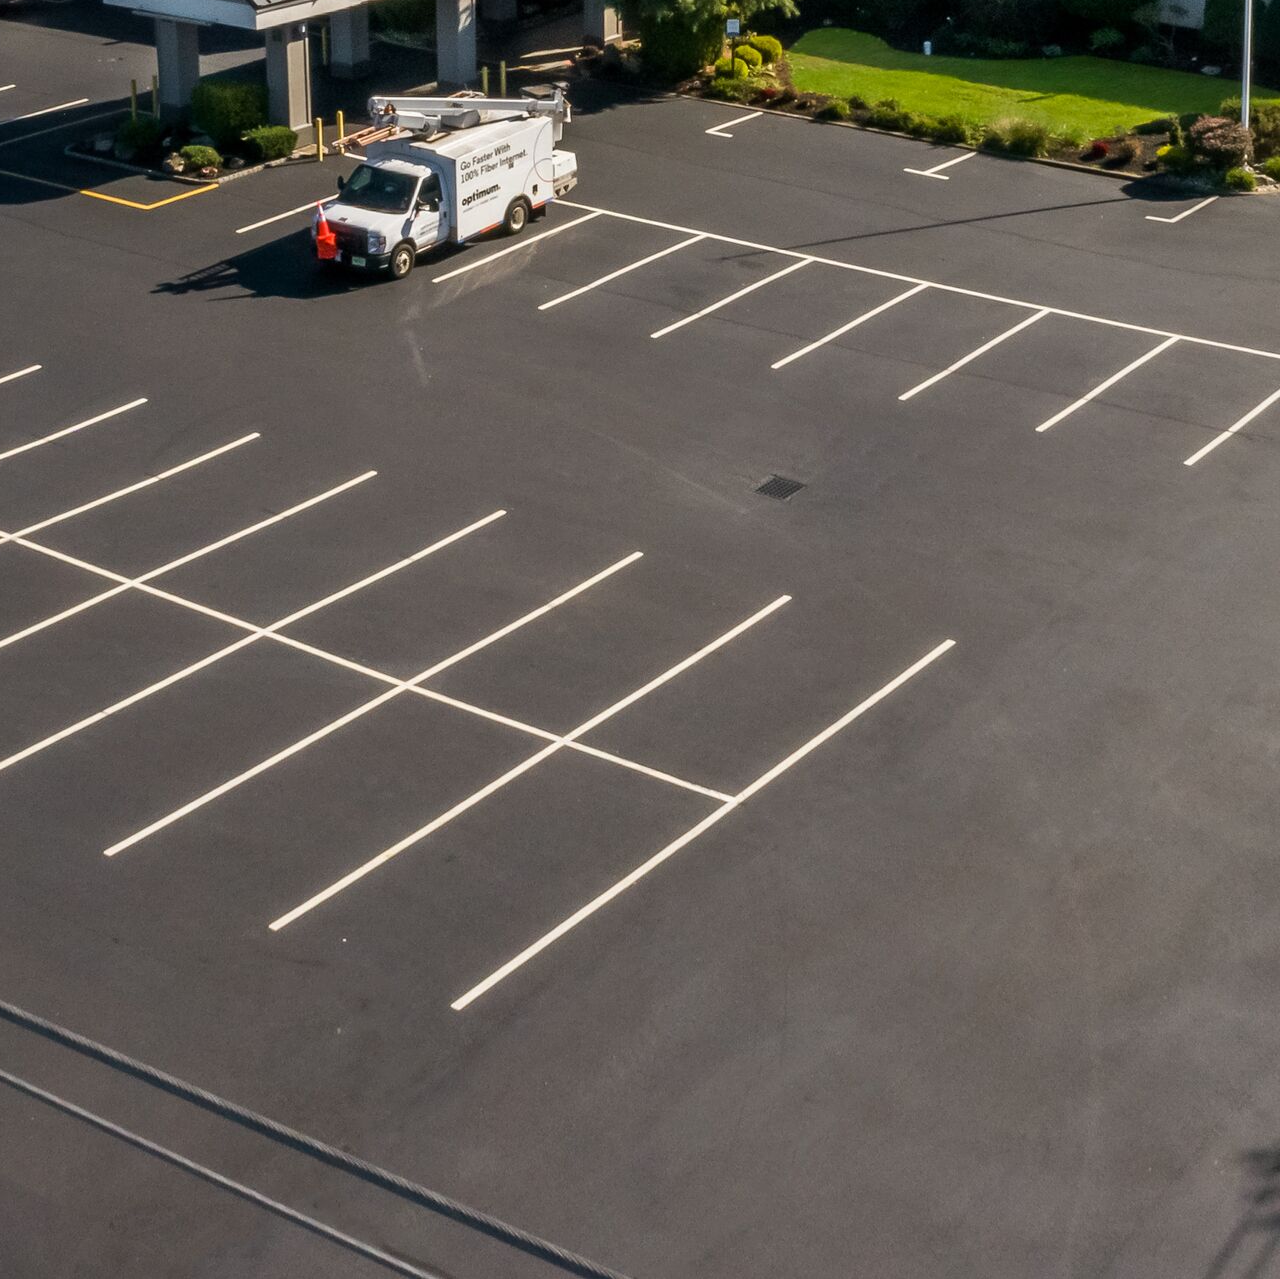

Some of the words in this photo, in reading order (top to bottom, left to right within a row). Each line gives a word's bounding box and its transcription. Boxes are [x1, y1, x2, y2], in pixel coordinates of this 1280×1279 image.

[460, 161, 471, 171] Go
[472, 151, 493, 166] Faster
[494, 143, 511, 156] With
[461, 170, 479, 184] 100%
[481, 161, 498, 175] Fiber
